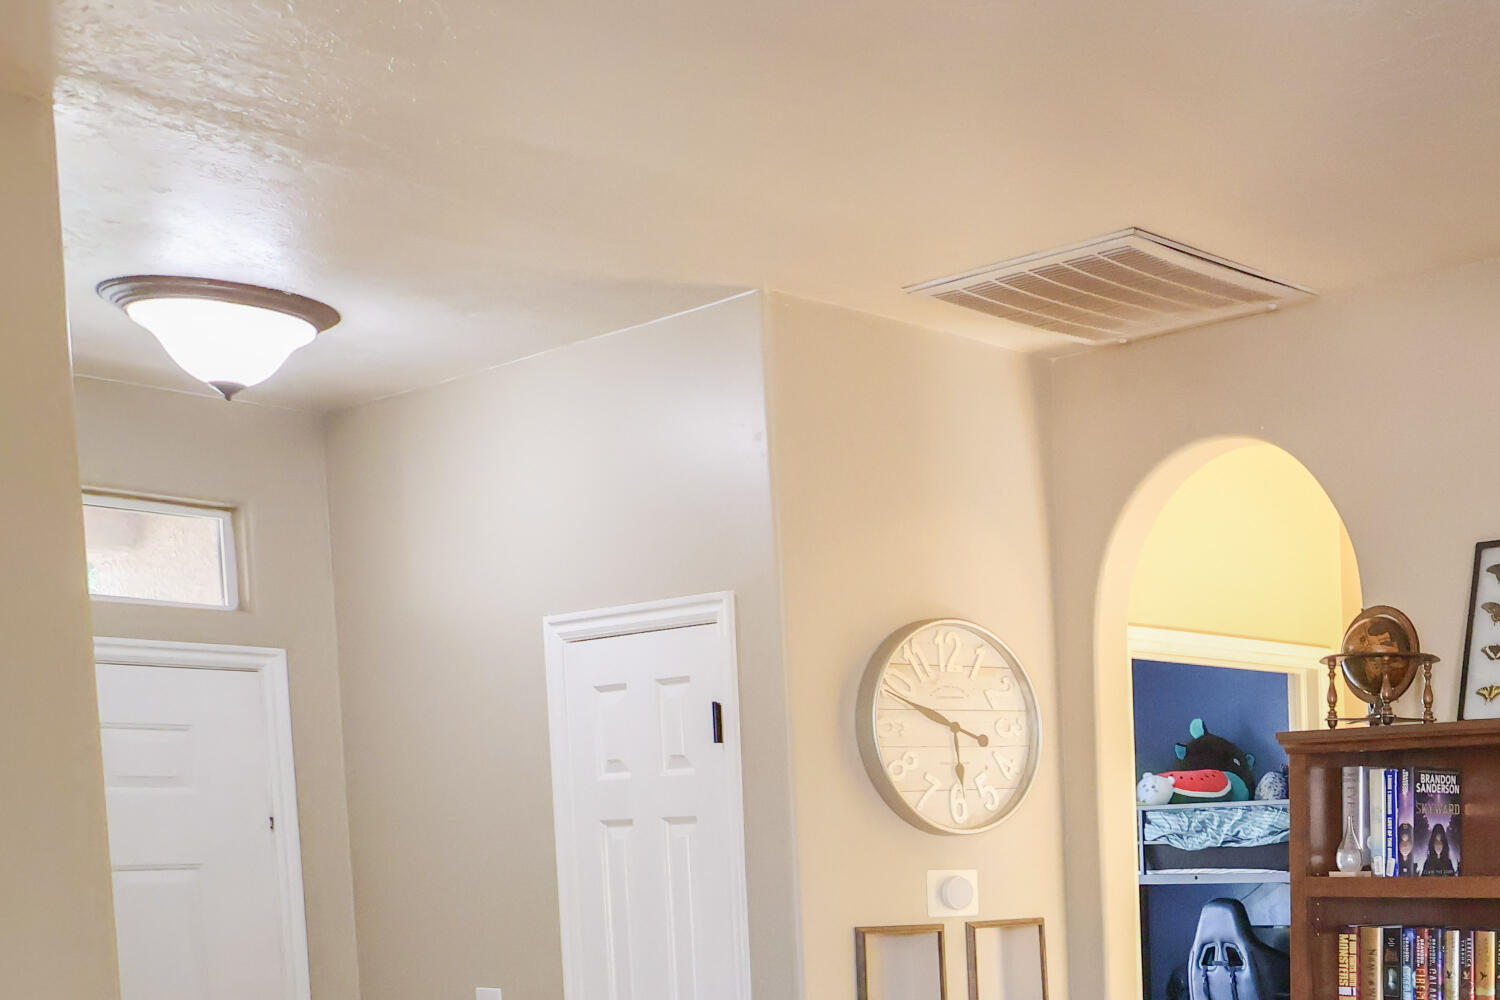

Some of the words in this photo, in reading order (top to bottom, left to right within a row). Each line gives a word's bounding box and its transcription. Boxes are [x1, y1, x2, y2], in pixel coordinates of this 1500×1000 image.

[903, 639, 935, 684] 11
[934, 631, 964, 672] 12
[968, 645, 986, 680] 1
[983, 676, 1011, 709] 2
[994, 717, 1024, 738] 3
[887, 751, 920, 780] 8
[992, 750, 1020, 781] 4
[1420, 774, 1457, 784] BRANDON
[915, 771, 942, 811] 7
[950, 782, 969, 824] 6
[973, 771, 1000, 812] 5
[1416, 784, 1460, 794] SANDERSON
[1416, 803, 1460, 815] SKYWARD
[1338, 934, 1349, 987] MONSTERS
